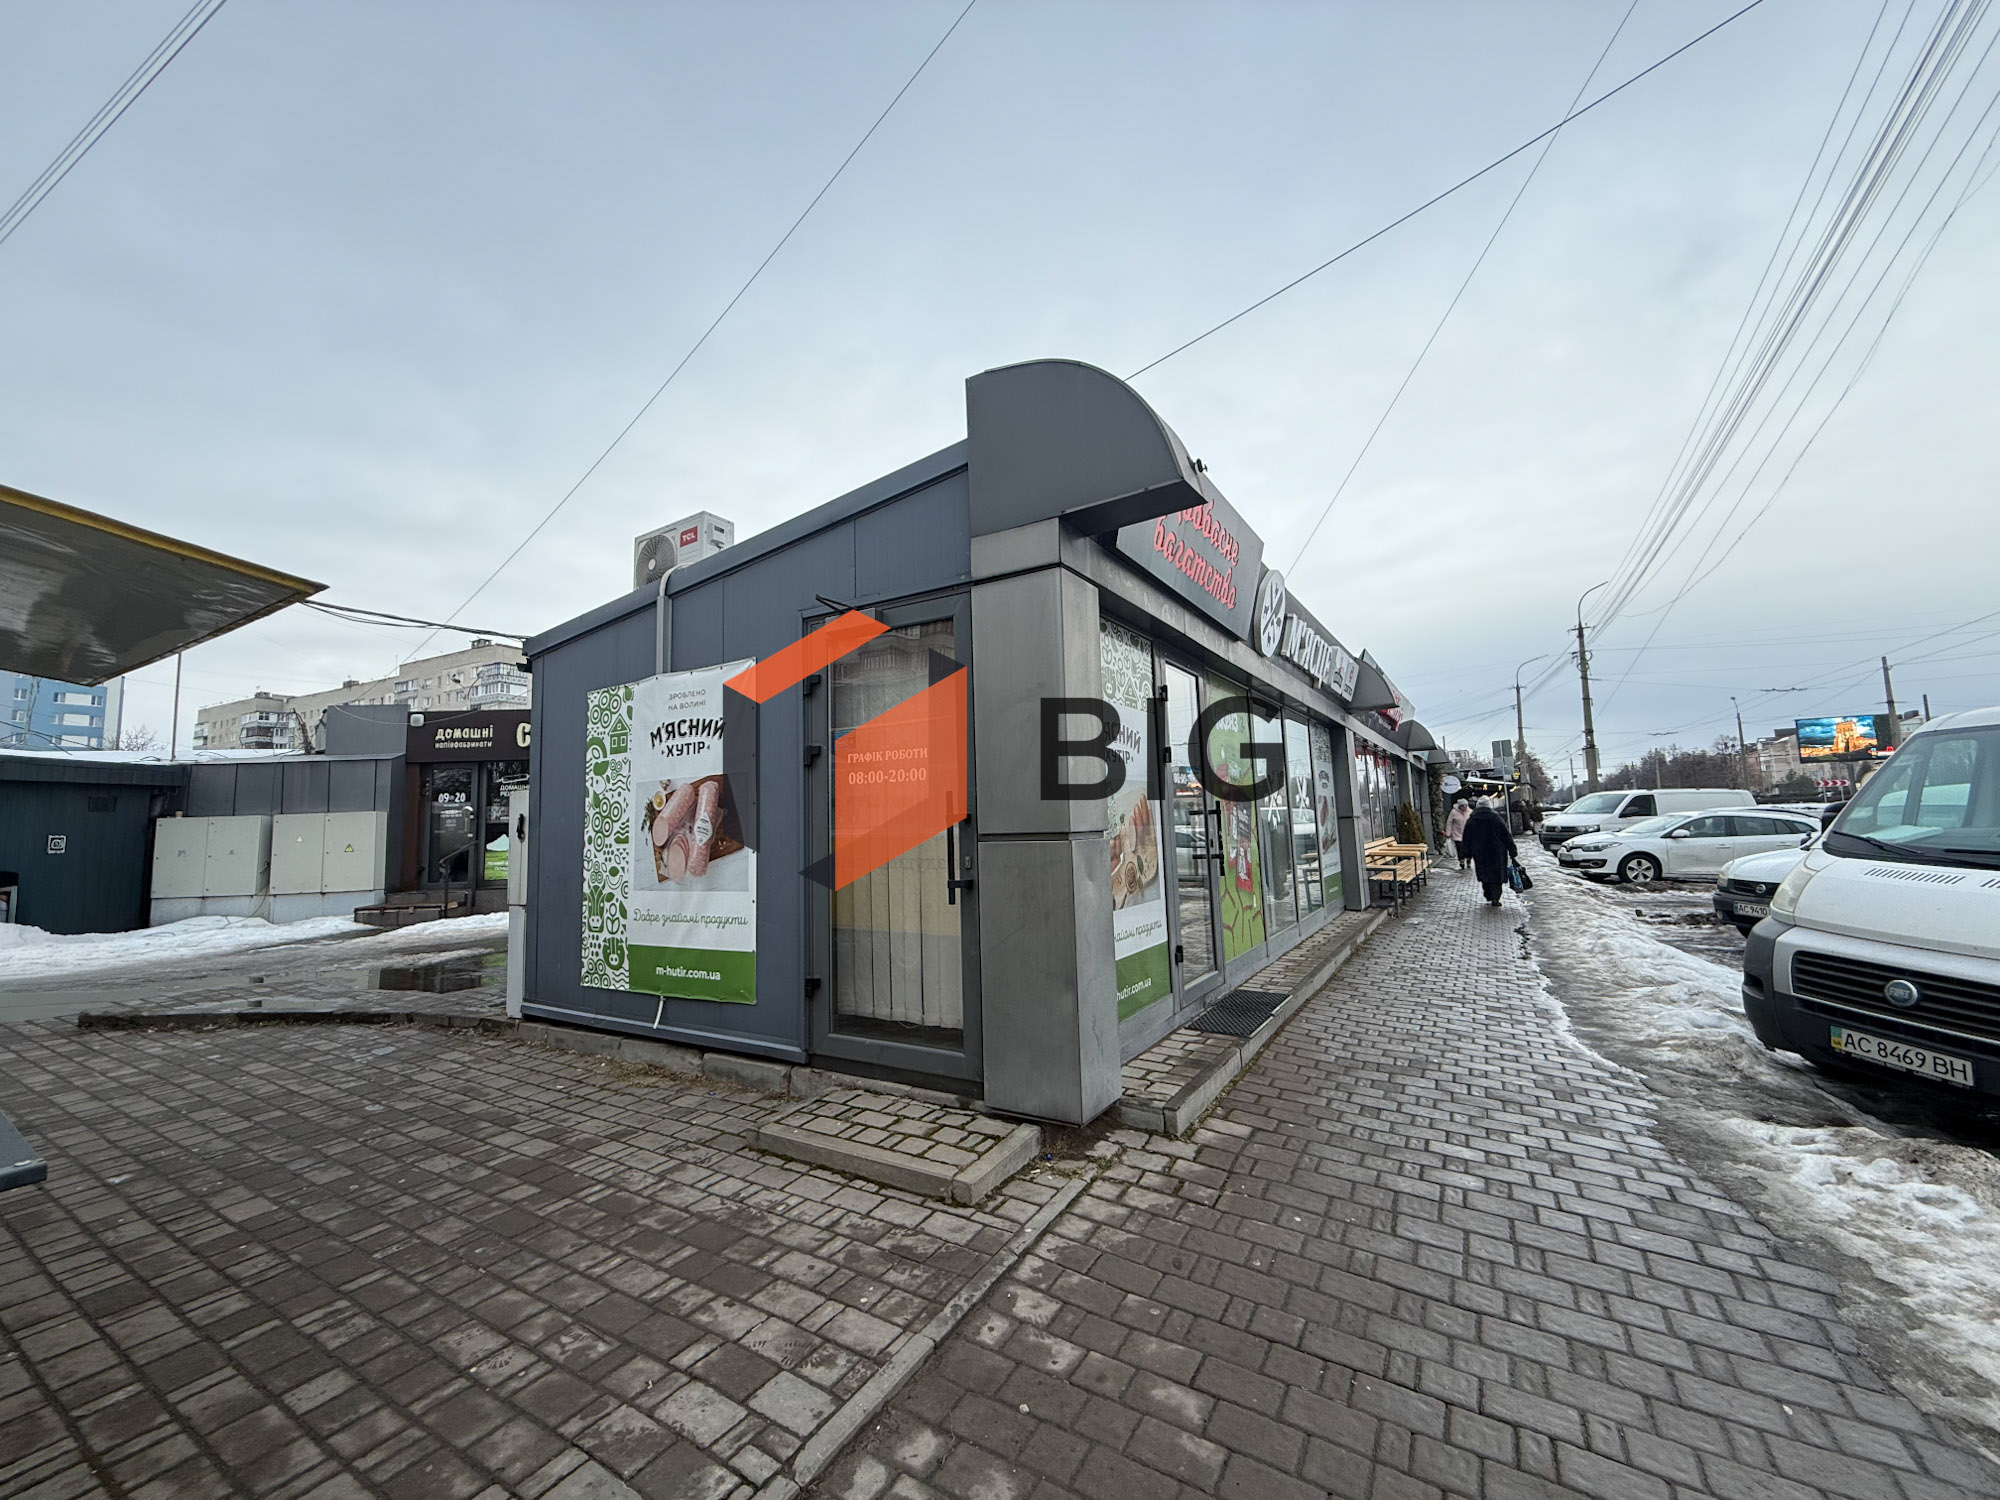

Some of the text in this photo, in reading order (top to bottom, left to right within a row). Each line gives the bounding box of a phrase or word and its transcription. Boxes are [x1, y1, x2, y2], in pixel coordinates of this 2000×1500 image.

[682, 532, 696, 542] TCL
[1153, 514, 1237, 610] багатство
[668, 689, 706, 700] ЗРОБЛЕНО
[679, 700, 706, 709] ВОЛИНІ
[650, 717, 726, 750] М'ЯСНИЙ
[434, 741, 492, 749] напівфабрикати
[666, 741, 705, 757] ХУТІР
[847, 747, 928, 764] ГРАФІК РОБОТИ
[848, 767, 927, 785] 08:00-20:00
[1738, 904, 1749, 913] AC
[633, 908, 660, 926] Добре
[700, 914, 748, 929] продукти
[655, 965, 721, 981] m-hutir.com.ua
[1844, 1033, 1872, 1053] AC
[1877, 1041, 1927, 1068] 8469
[1932, 1055, 1969, 1082] BH
